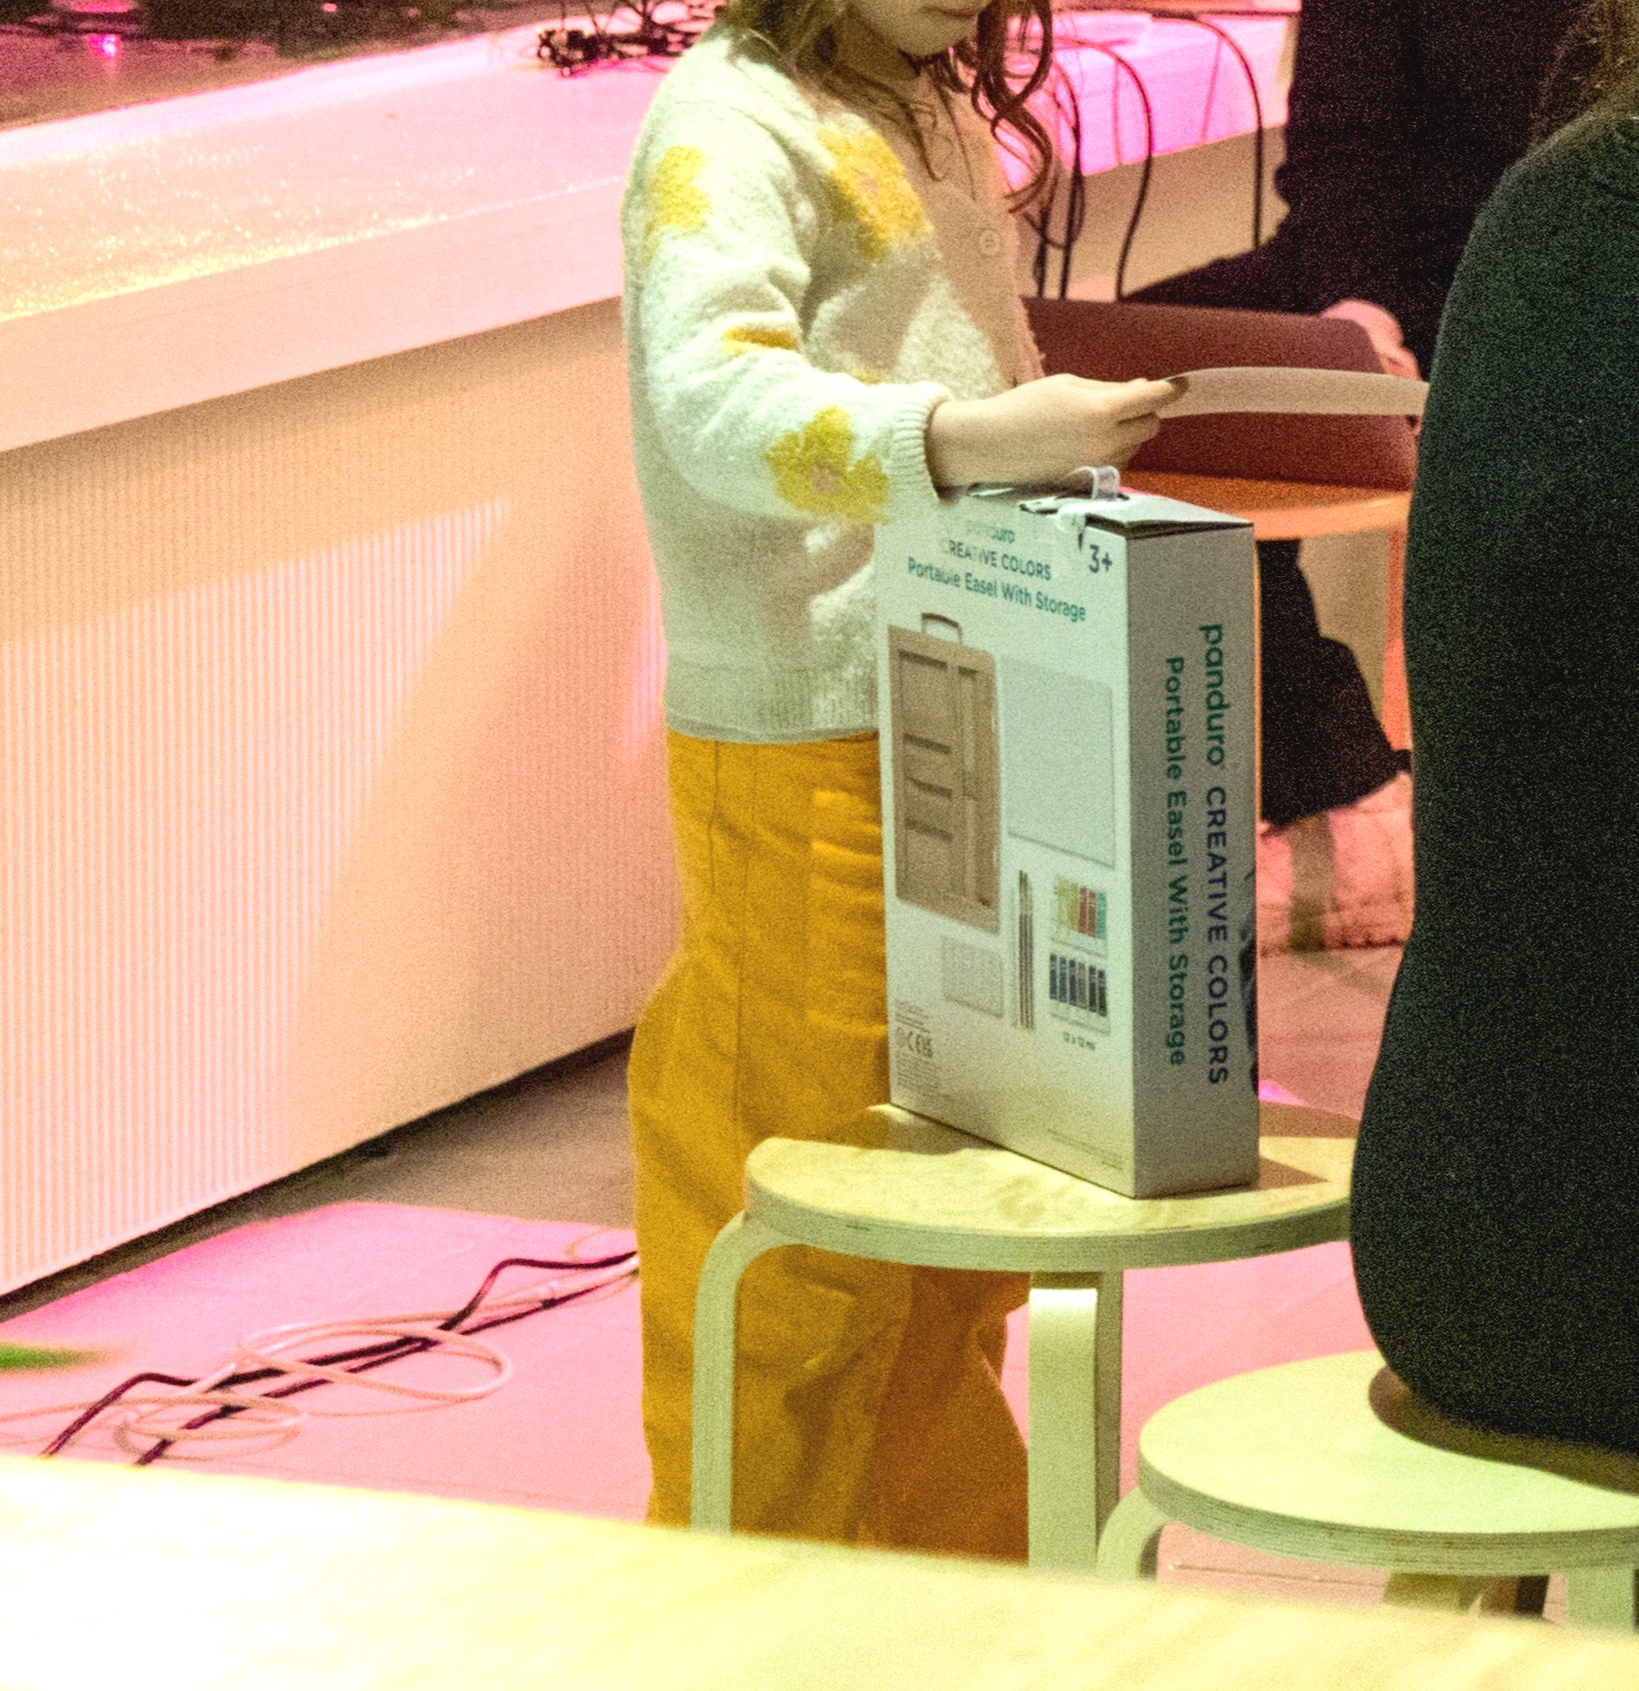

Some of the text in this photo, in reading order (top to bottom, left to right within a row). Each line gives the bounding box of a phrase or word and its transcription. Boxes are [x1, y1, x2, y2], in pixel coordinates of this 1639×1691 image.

[939, 538, 1051, 581] REAIVE COLORS
[1089, 543, 1113, 573] 3+
[965, 572, 998, 598] Easel
[1001, 582, 1032, 607] With
[1036, 591, 1086, 623] Storage
[1165, 656, 1188, 1066] Portable Easel With Storage
[1200, 624, 1230, 1084] panduro CREATIVE COLORS
